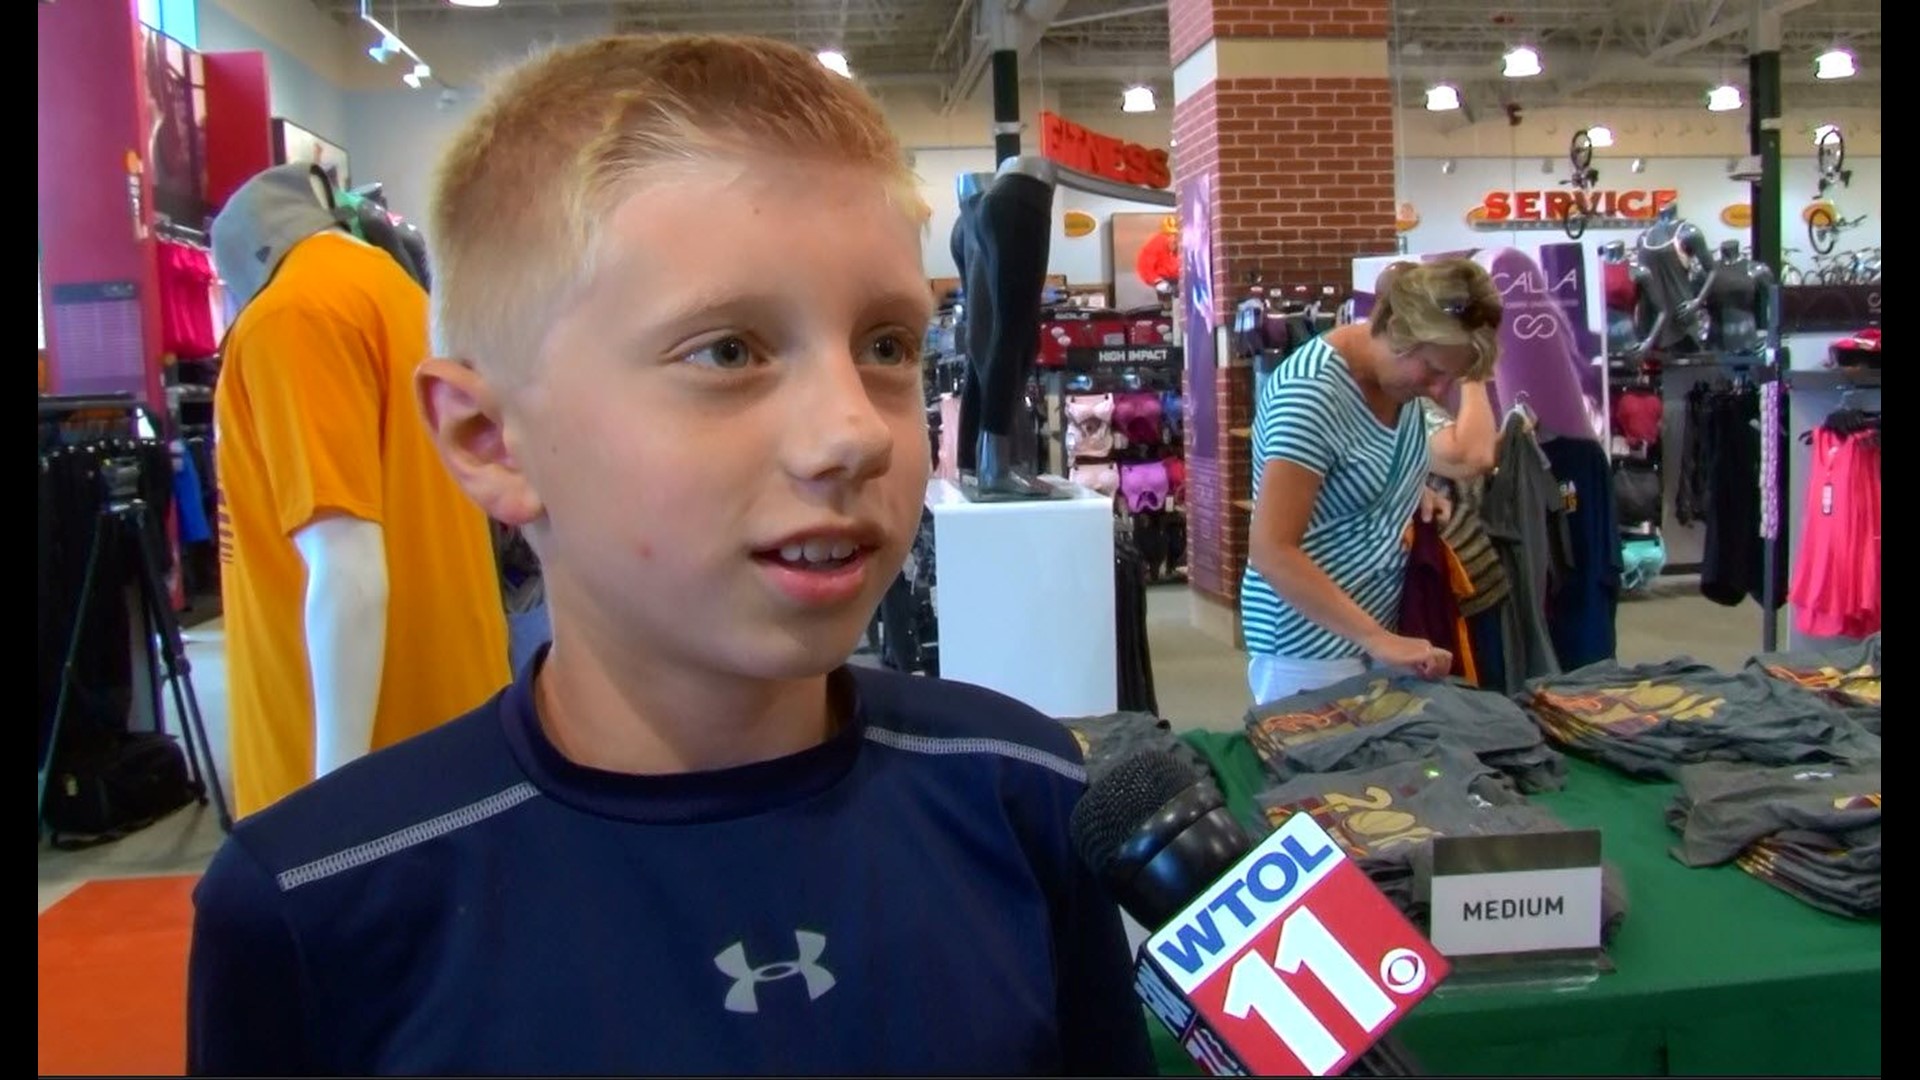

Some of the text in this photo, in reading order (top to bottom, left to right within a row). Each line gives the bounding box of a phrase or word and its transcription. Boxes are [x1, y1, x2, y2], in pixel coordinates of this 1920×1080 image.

[1484, 190, 1678, 221] SERVICE
[1099, 349, 1168, 362] HIGH IMPACT
[1157, 834, 1334, 975] WTOL
[1463, 896, 1564, 922] MEDIUM
[1222, 904, 1398, 1076] 11
